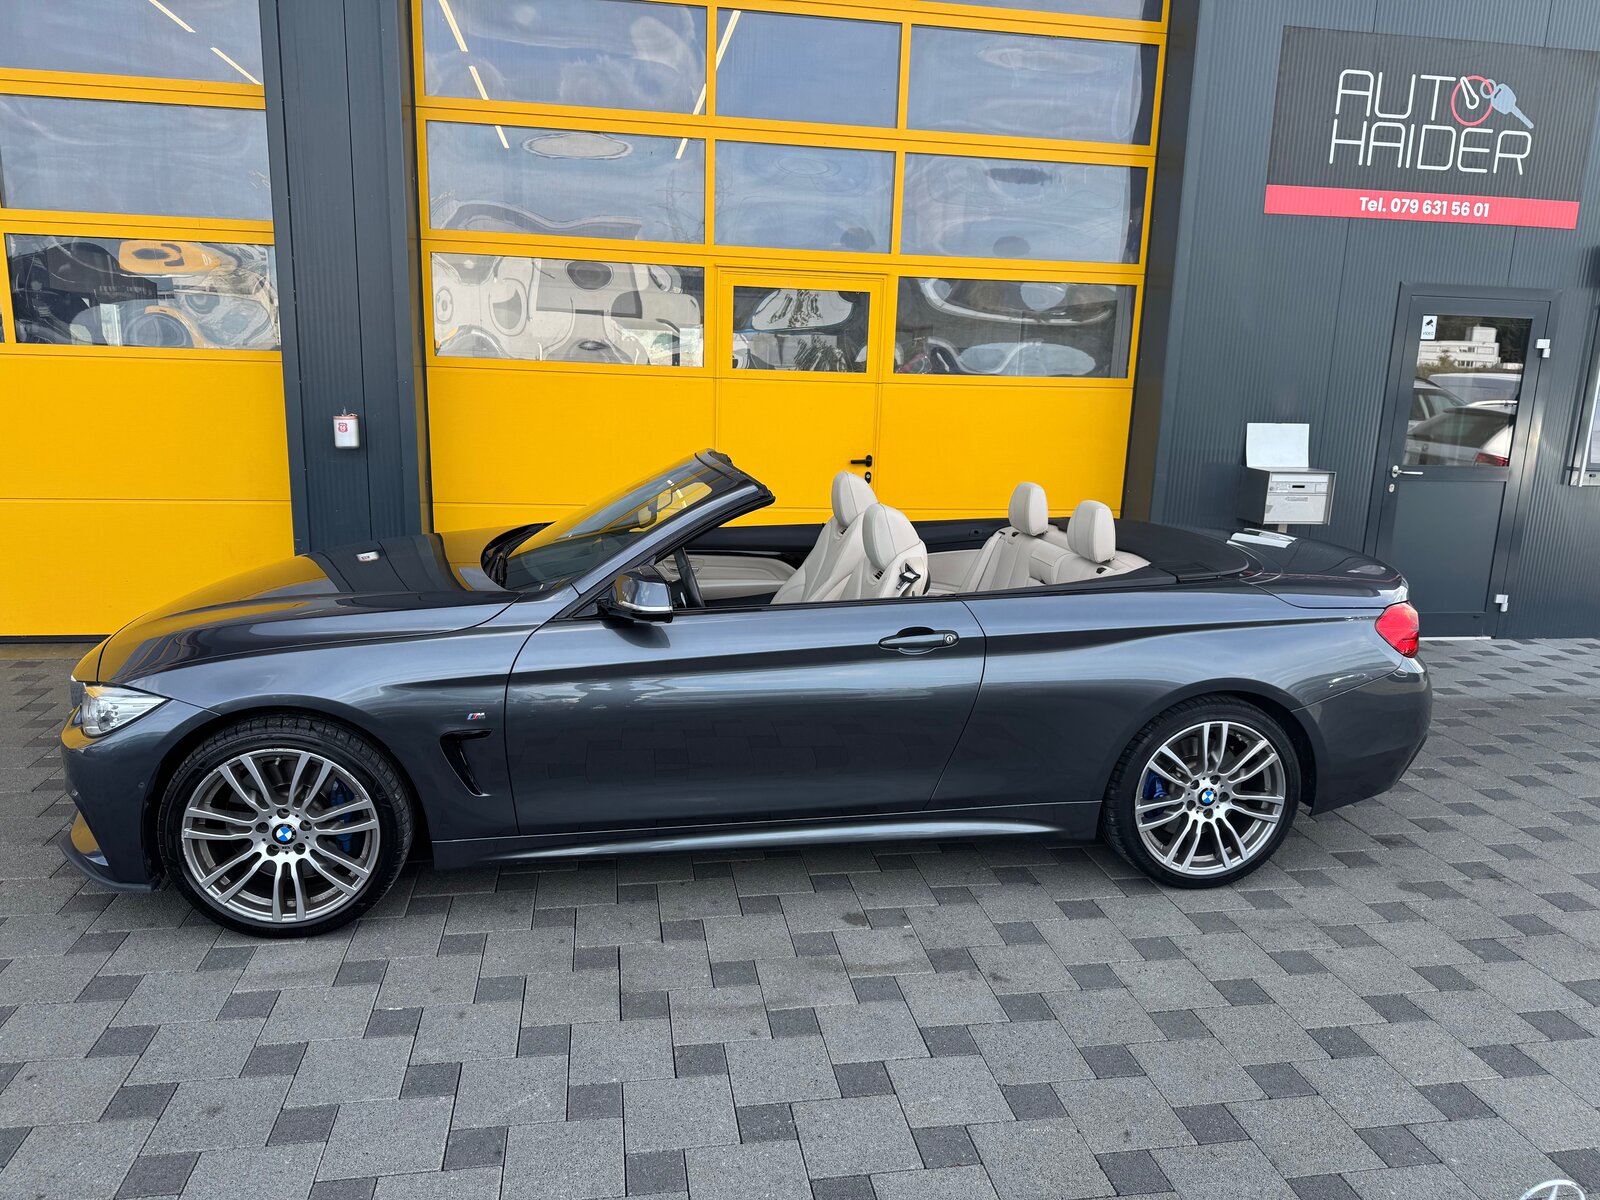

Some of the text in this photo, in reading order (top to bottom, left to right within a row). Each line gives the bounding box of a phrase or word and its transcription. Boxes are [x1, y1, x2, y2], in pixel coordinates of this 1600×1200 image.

[1335, 69, 1494, 126] AUTO
[1329, 119, 1532, 175] HAIDER
[1359, 196, 1490, 218] Tel. 079 631 56 01
